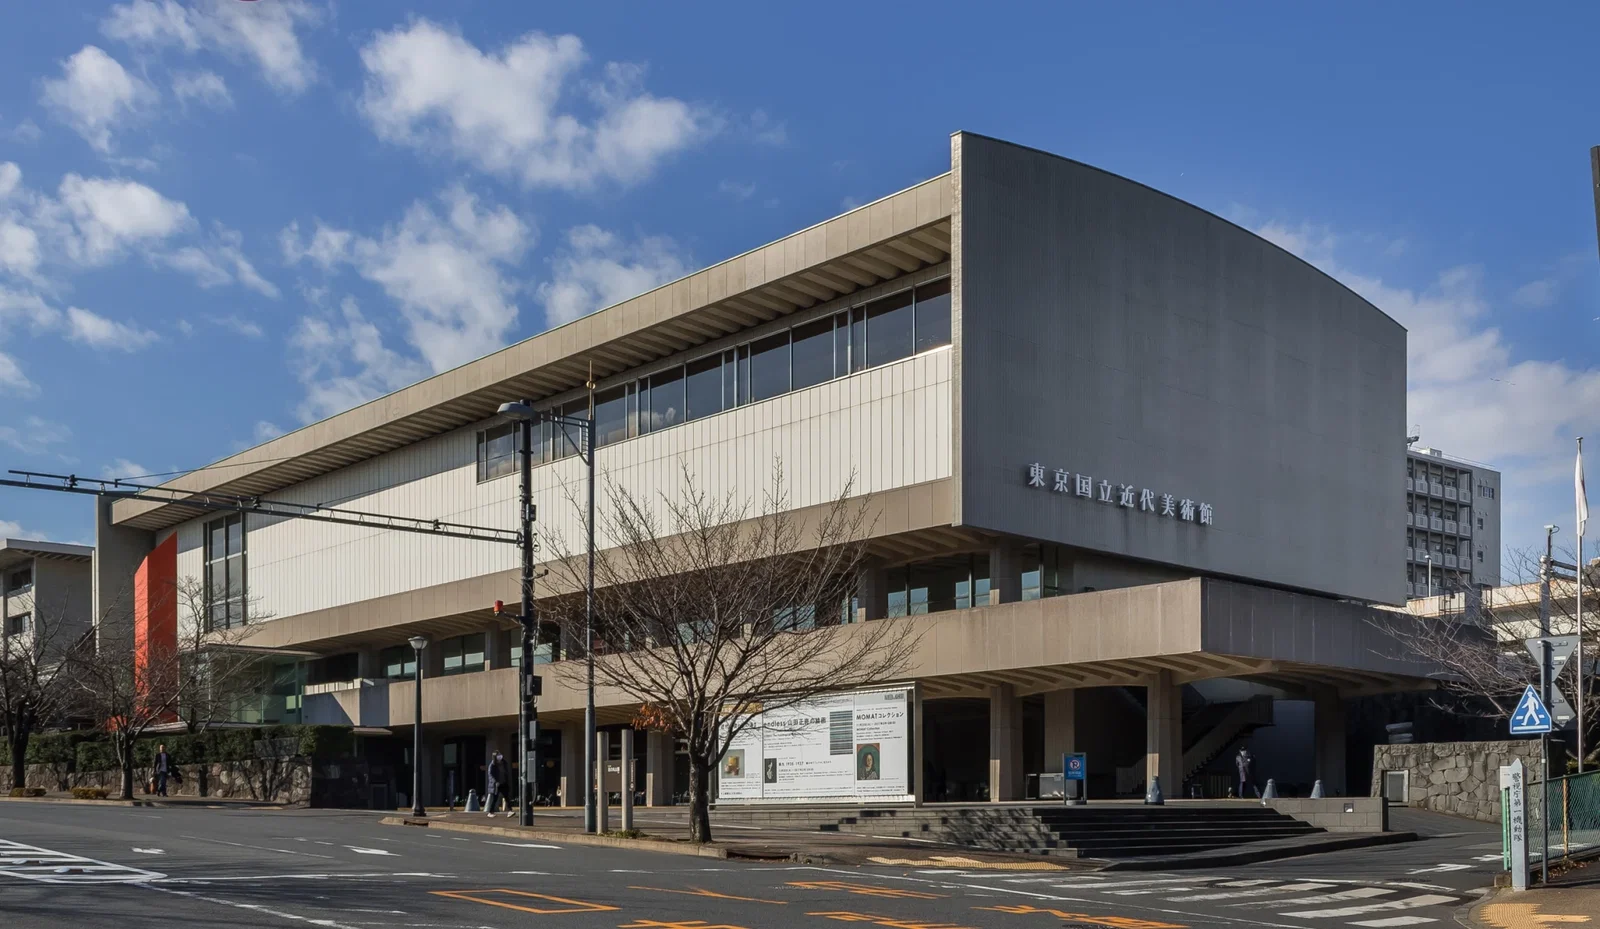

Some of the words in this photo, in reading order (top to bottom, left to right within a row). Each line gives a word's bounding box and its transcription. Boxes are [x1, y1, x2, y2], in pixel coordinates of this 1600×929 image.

[1028, 462, 1213, 525] 東京国立近代美術館
[1512, 772, 1522, 842] 警視庁第一機動隊
